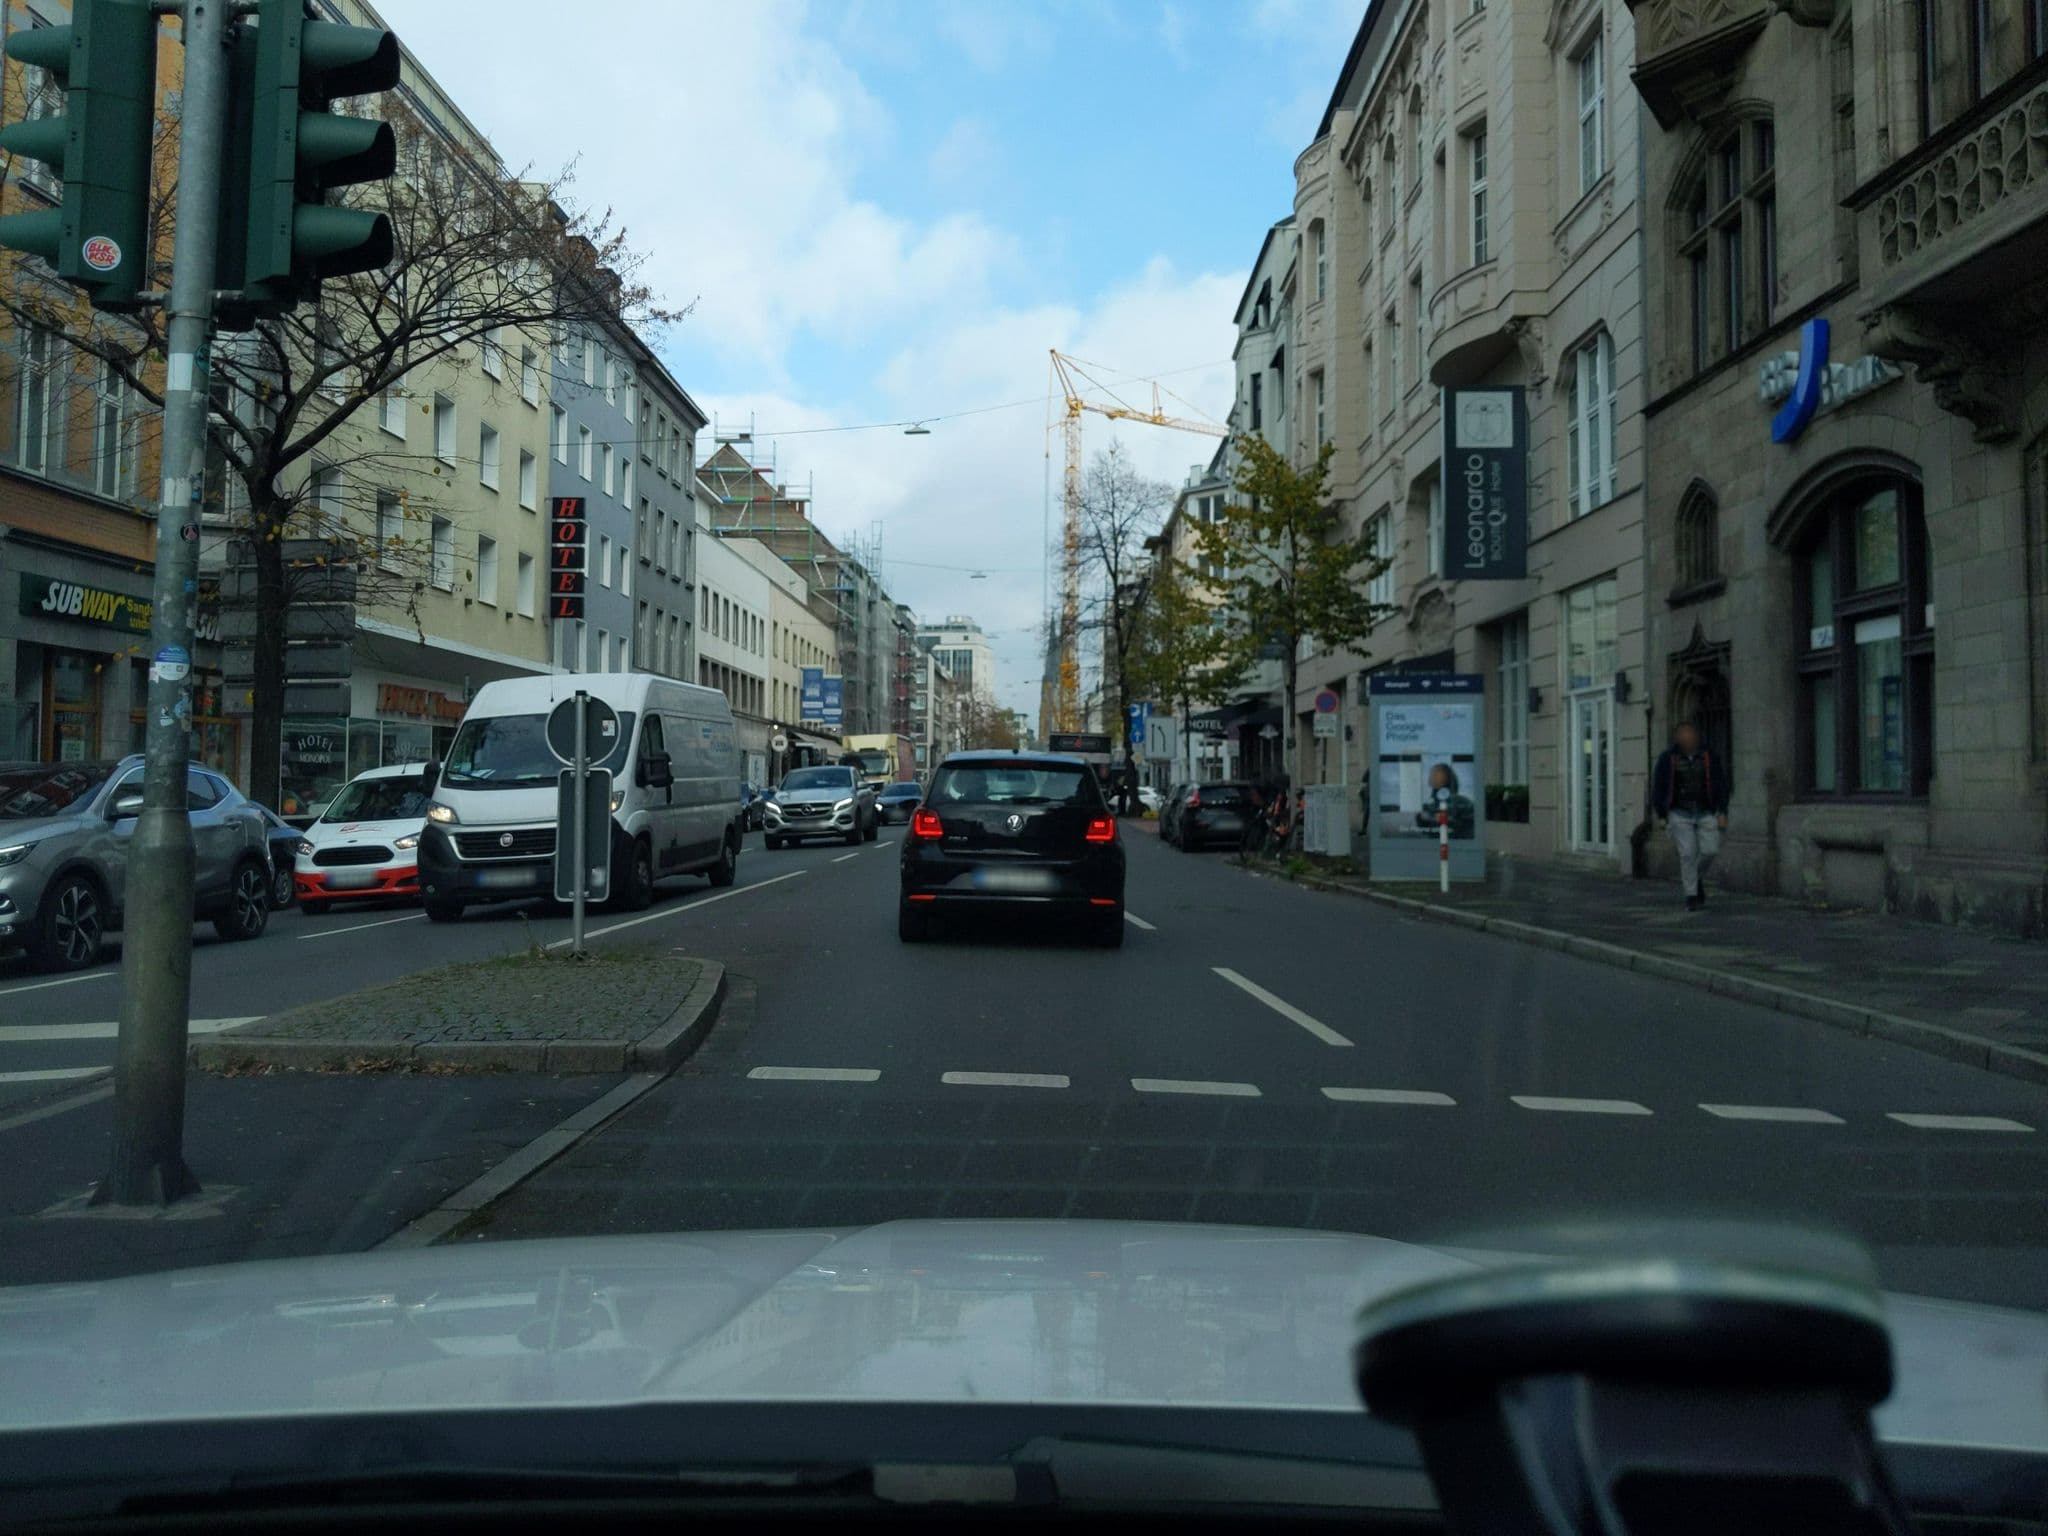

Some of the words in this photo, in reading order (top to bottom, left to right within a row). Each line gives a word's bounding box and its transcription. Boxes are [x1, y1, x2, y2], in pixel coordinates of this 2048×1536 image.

[1464, 453, 1485, 568] Leonardo
[558, 498, 577, 617] HOTEL
[41, 580, 126, 622] SUBWAY
[1385, 721, 1425, 732] Google
[1385, 731, 1419, 741] Phone
[297, 734, 335, 752] HOTEL
